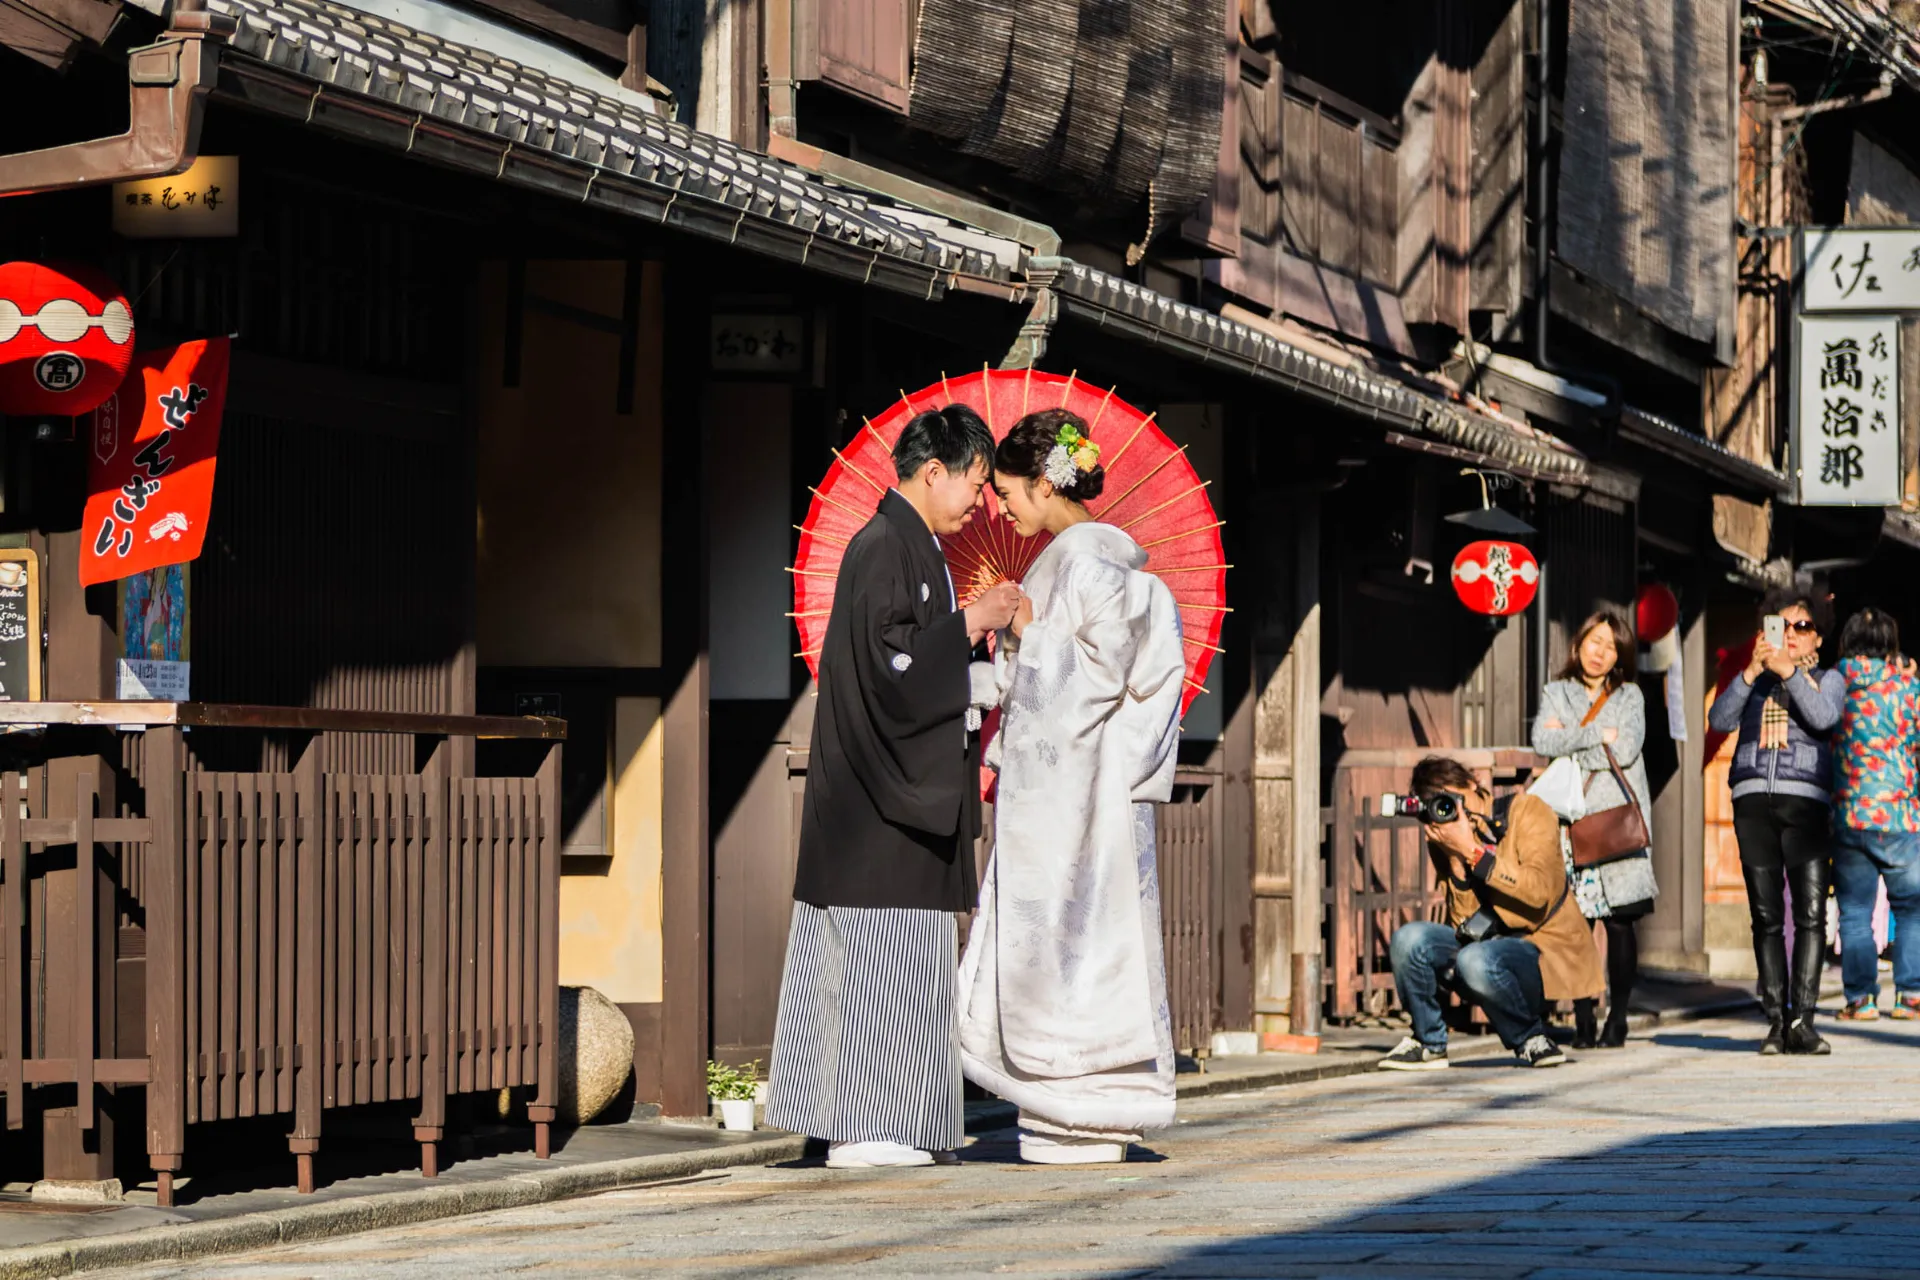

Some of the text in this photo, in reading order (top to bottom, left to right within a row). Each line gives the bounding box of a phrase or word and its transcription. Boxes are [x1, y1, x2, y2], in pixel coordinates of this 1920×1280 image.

[1830, 241, 1882, 299] 佐
[94, 383, 208, 557] ぜんざい
[1820, 338, 1864, 488] 萬治郎
